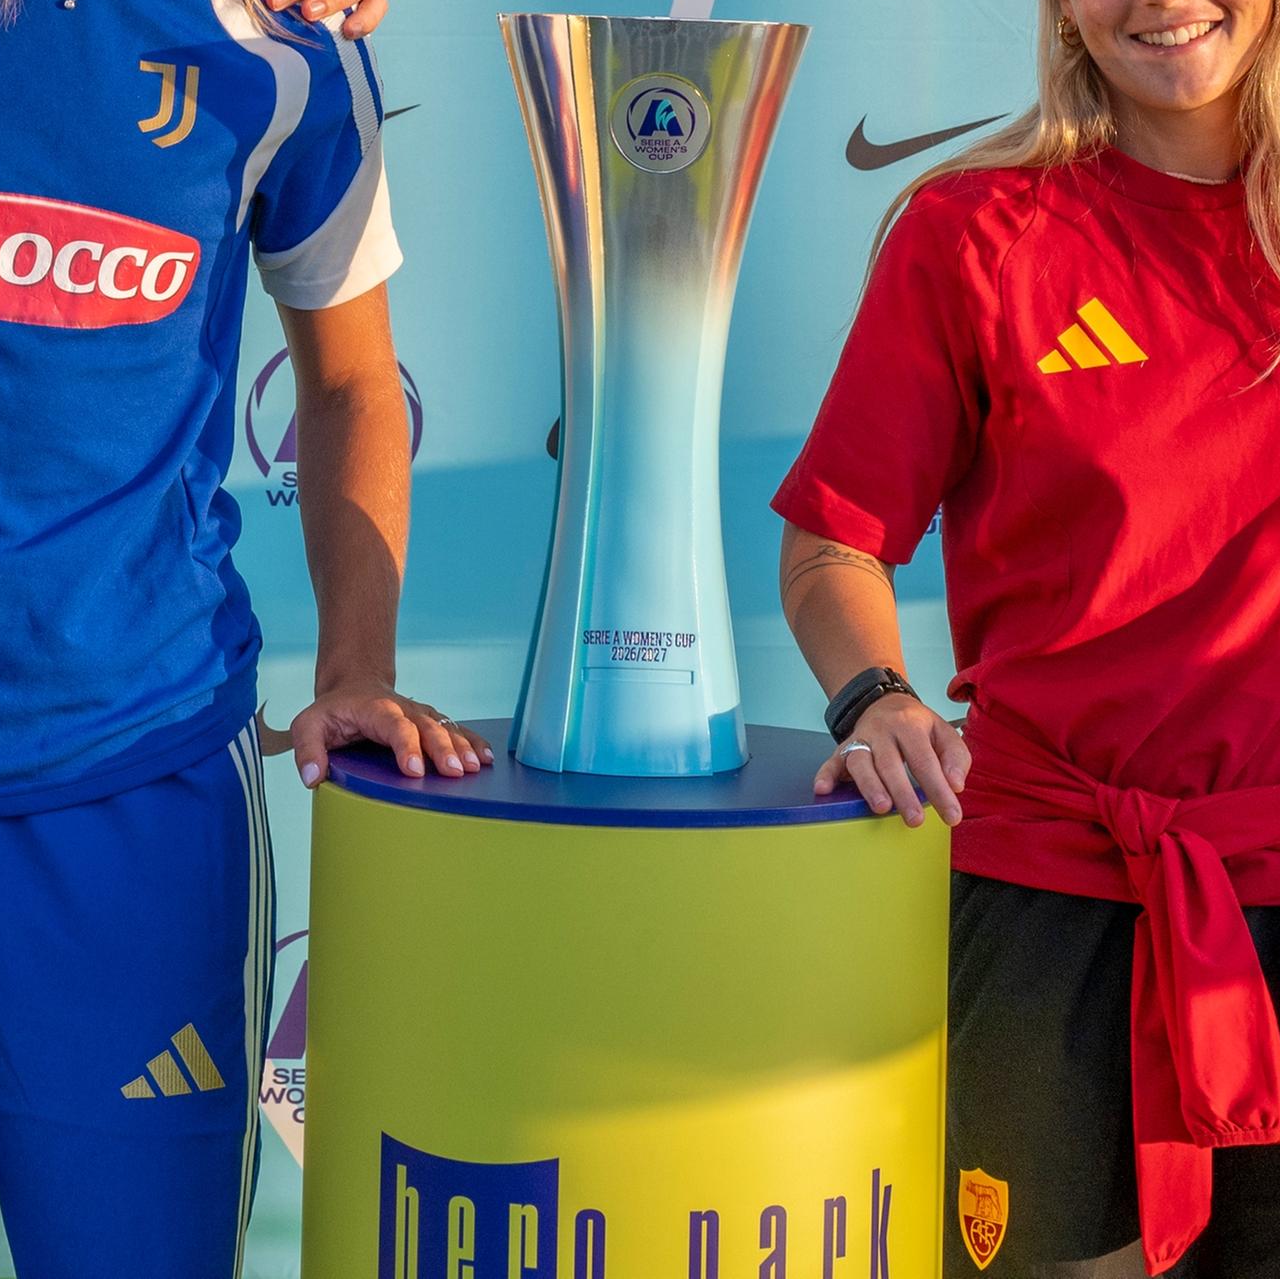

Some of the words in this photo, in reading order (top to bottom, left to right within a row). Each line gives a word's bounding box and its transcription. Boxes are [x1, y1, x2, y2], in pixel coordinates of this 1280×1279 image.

[648, 153, 673, 161] CUP
[583, 629, 611, 645] SERIE
[613, 630, 620, 645] A
[674, 632, 696, 648] CUP
[611, 646, 668, 662] 2026/2027
